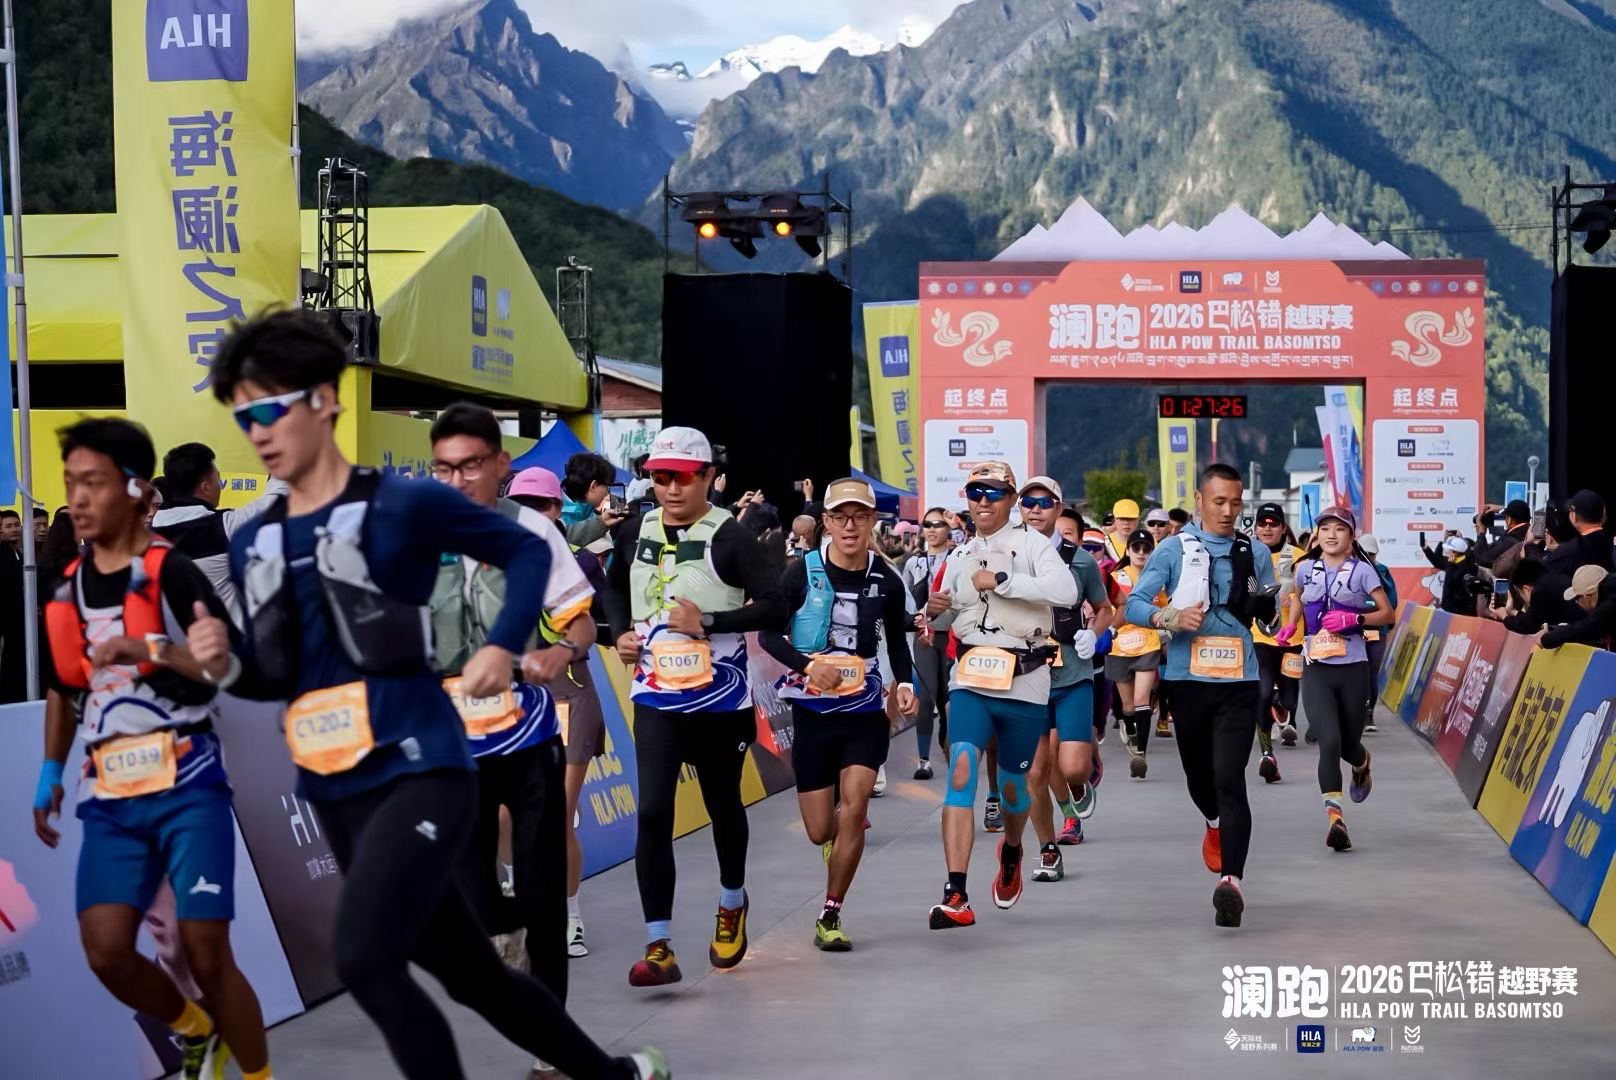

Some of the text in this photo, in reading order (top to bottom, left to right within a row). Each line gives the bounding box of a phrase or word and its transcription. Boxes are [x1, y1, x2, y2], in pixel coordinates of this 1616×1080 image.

[1183, 275, 1200, 284] HLA
[1049, 303, 1140, 349] 澜跑
[1150, 335, 1341, 349] HLA POW TRAIL BASOMTSO
[943, 388, 1008, 407] 起终点
[1393, 388, 1459, 407] 起终点
[659, 654, 700, 668] C1067
[1200, 649, 1236, 660] C1025
[968, 657, 1006, 670] C1071
[296, 708, 351, 738] C1202
[105, 747, 160, 772] C1039
